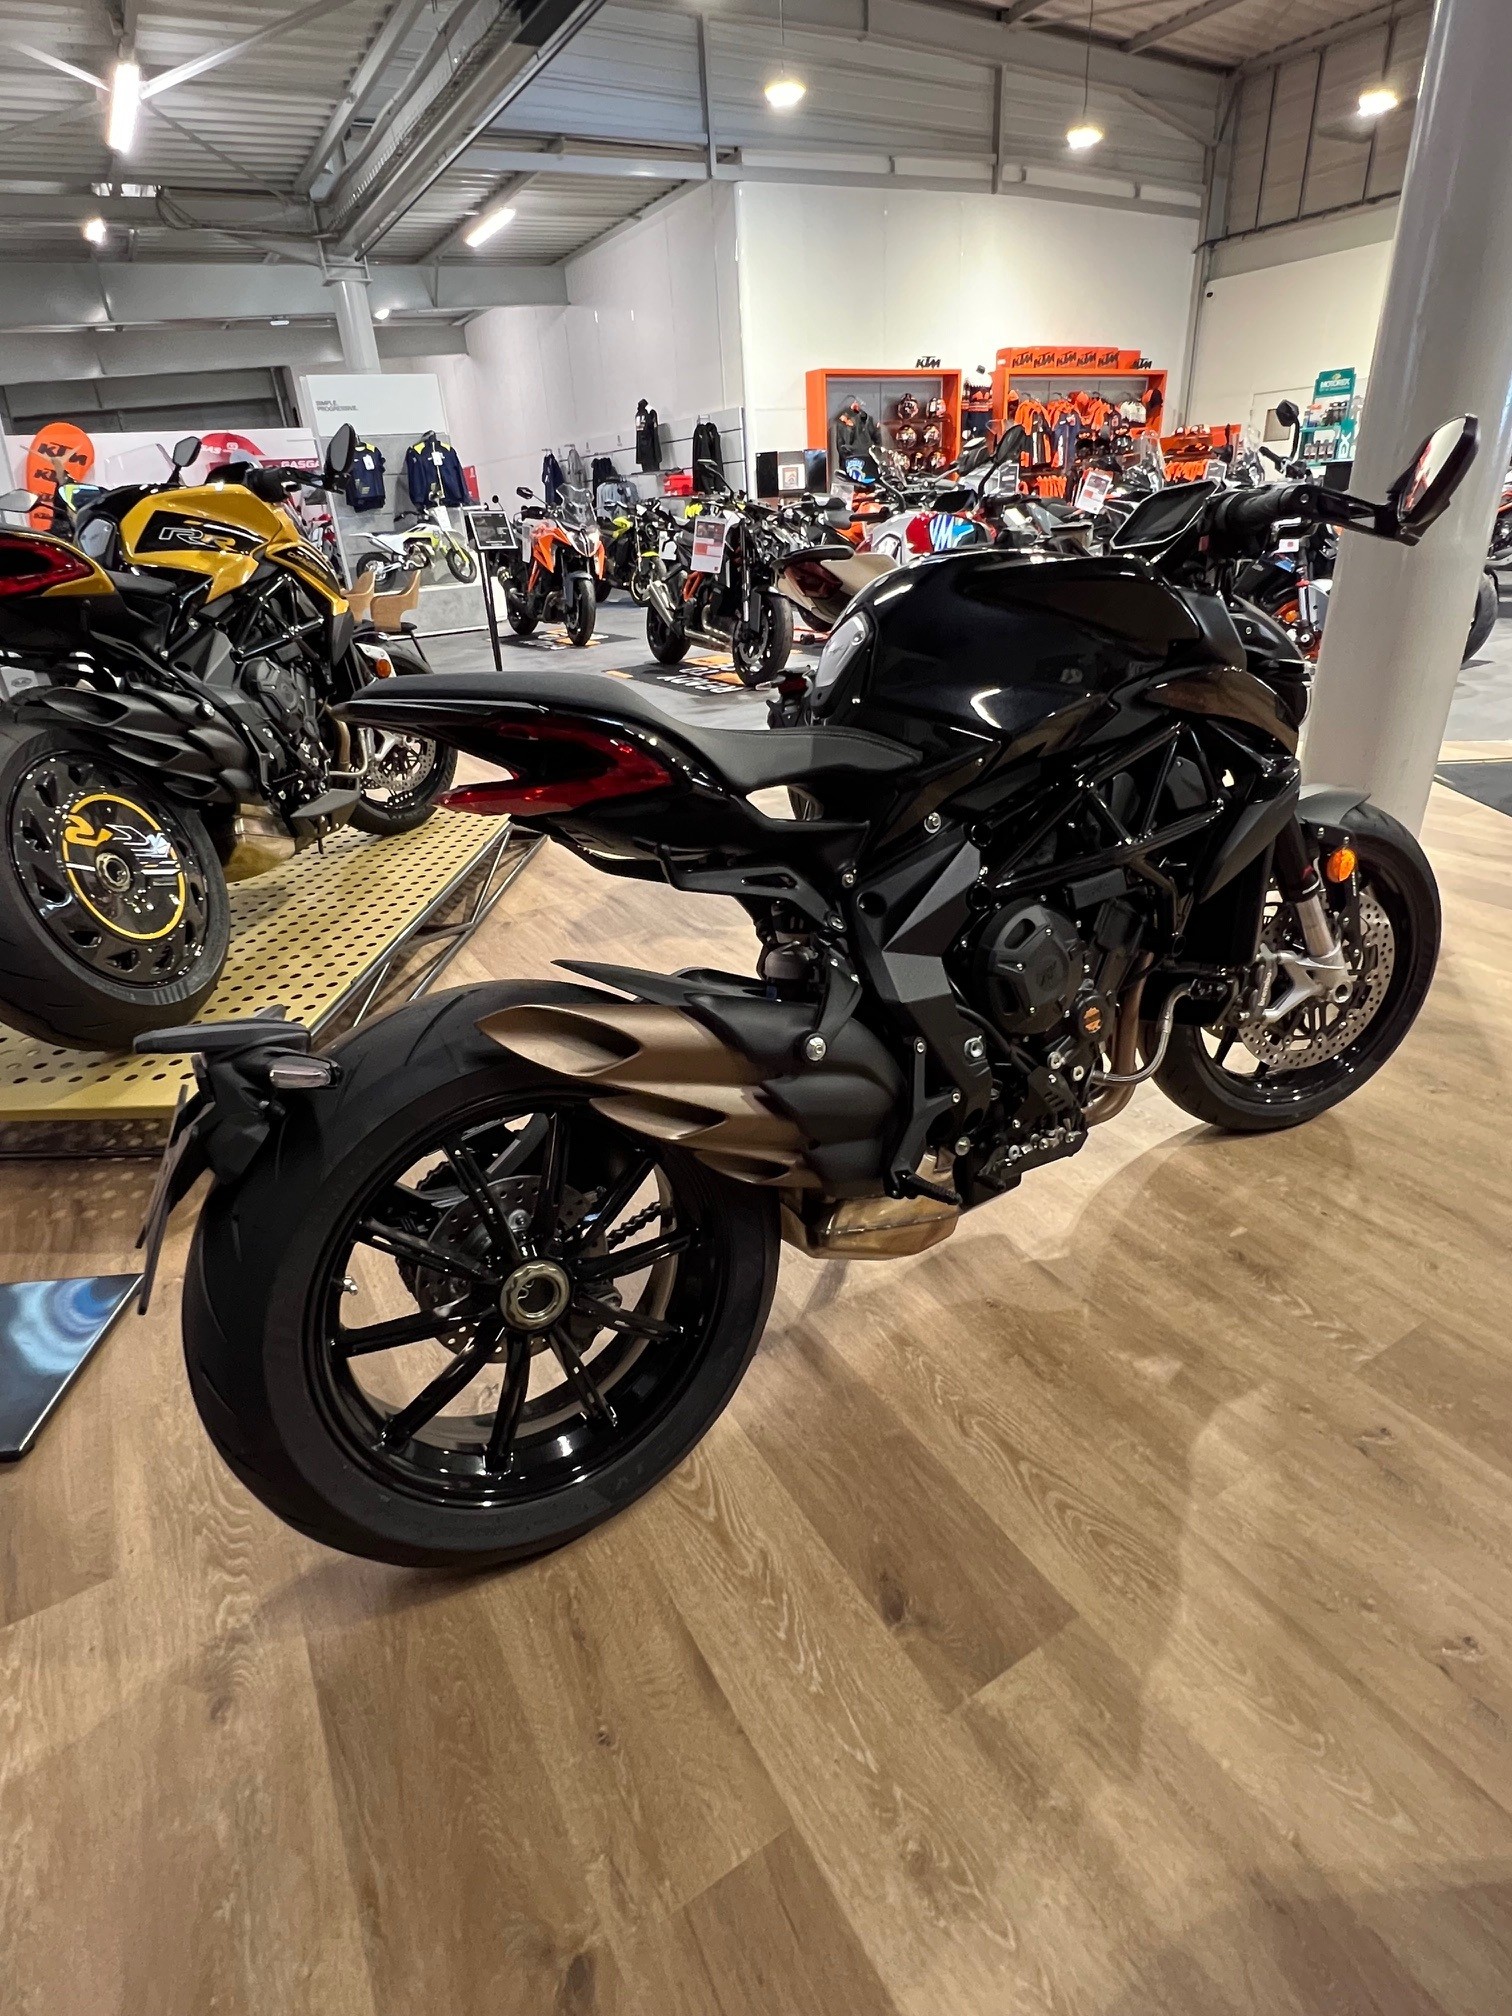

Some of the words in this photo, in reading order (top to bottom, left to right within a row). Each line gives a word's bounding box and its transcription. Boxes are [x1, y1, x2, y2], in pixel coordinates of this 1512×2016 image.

[915, 356, 941, 369] KTM
[1012, 352, 1034, 368] KTM
[1034, 352, 1055, 368] KTM
[1056, 351, 1077, 366] KTM
[1077, 352, 1097, 367] KTM
[1097, 351, 1119, 367] KTM
